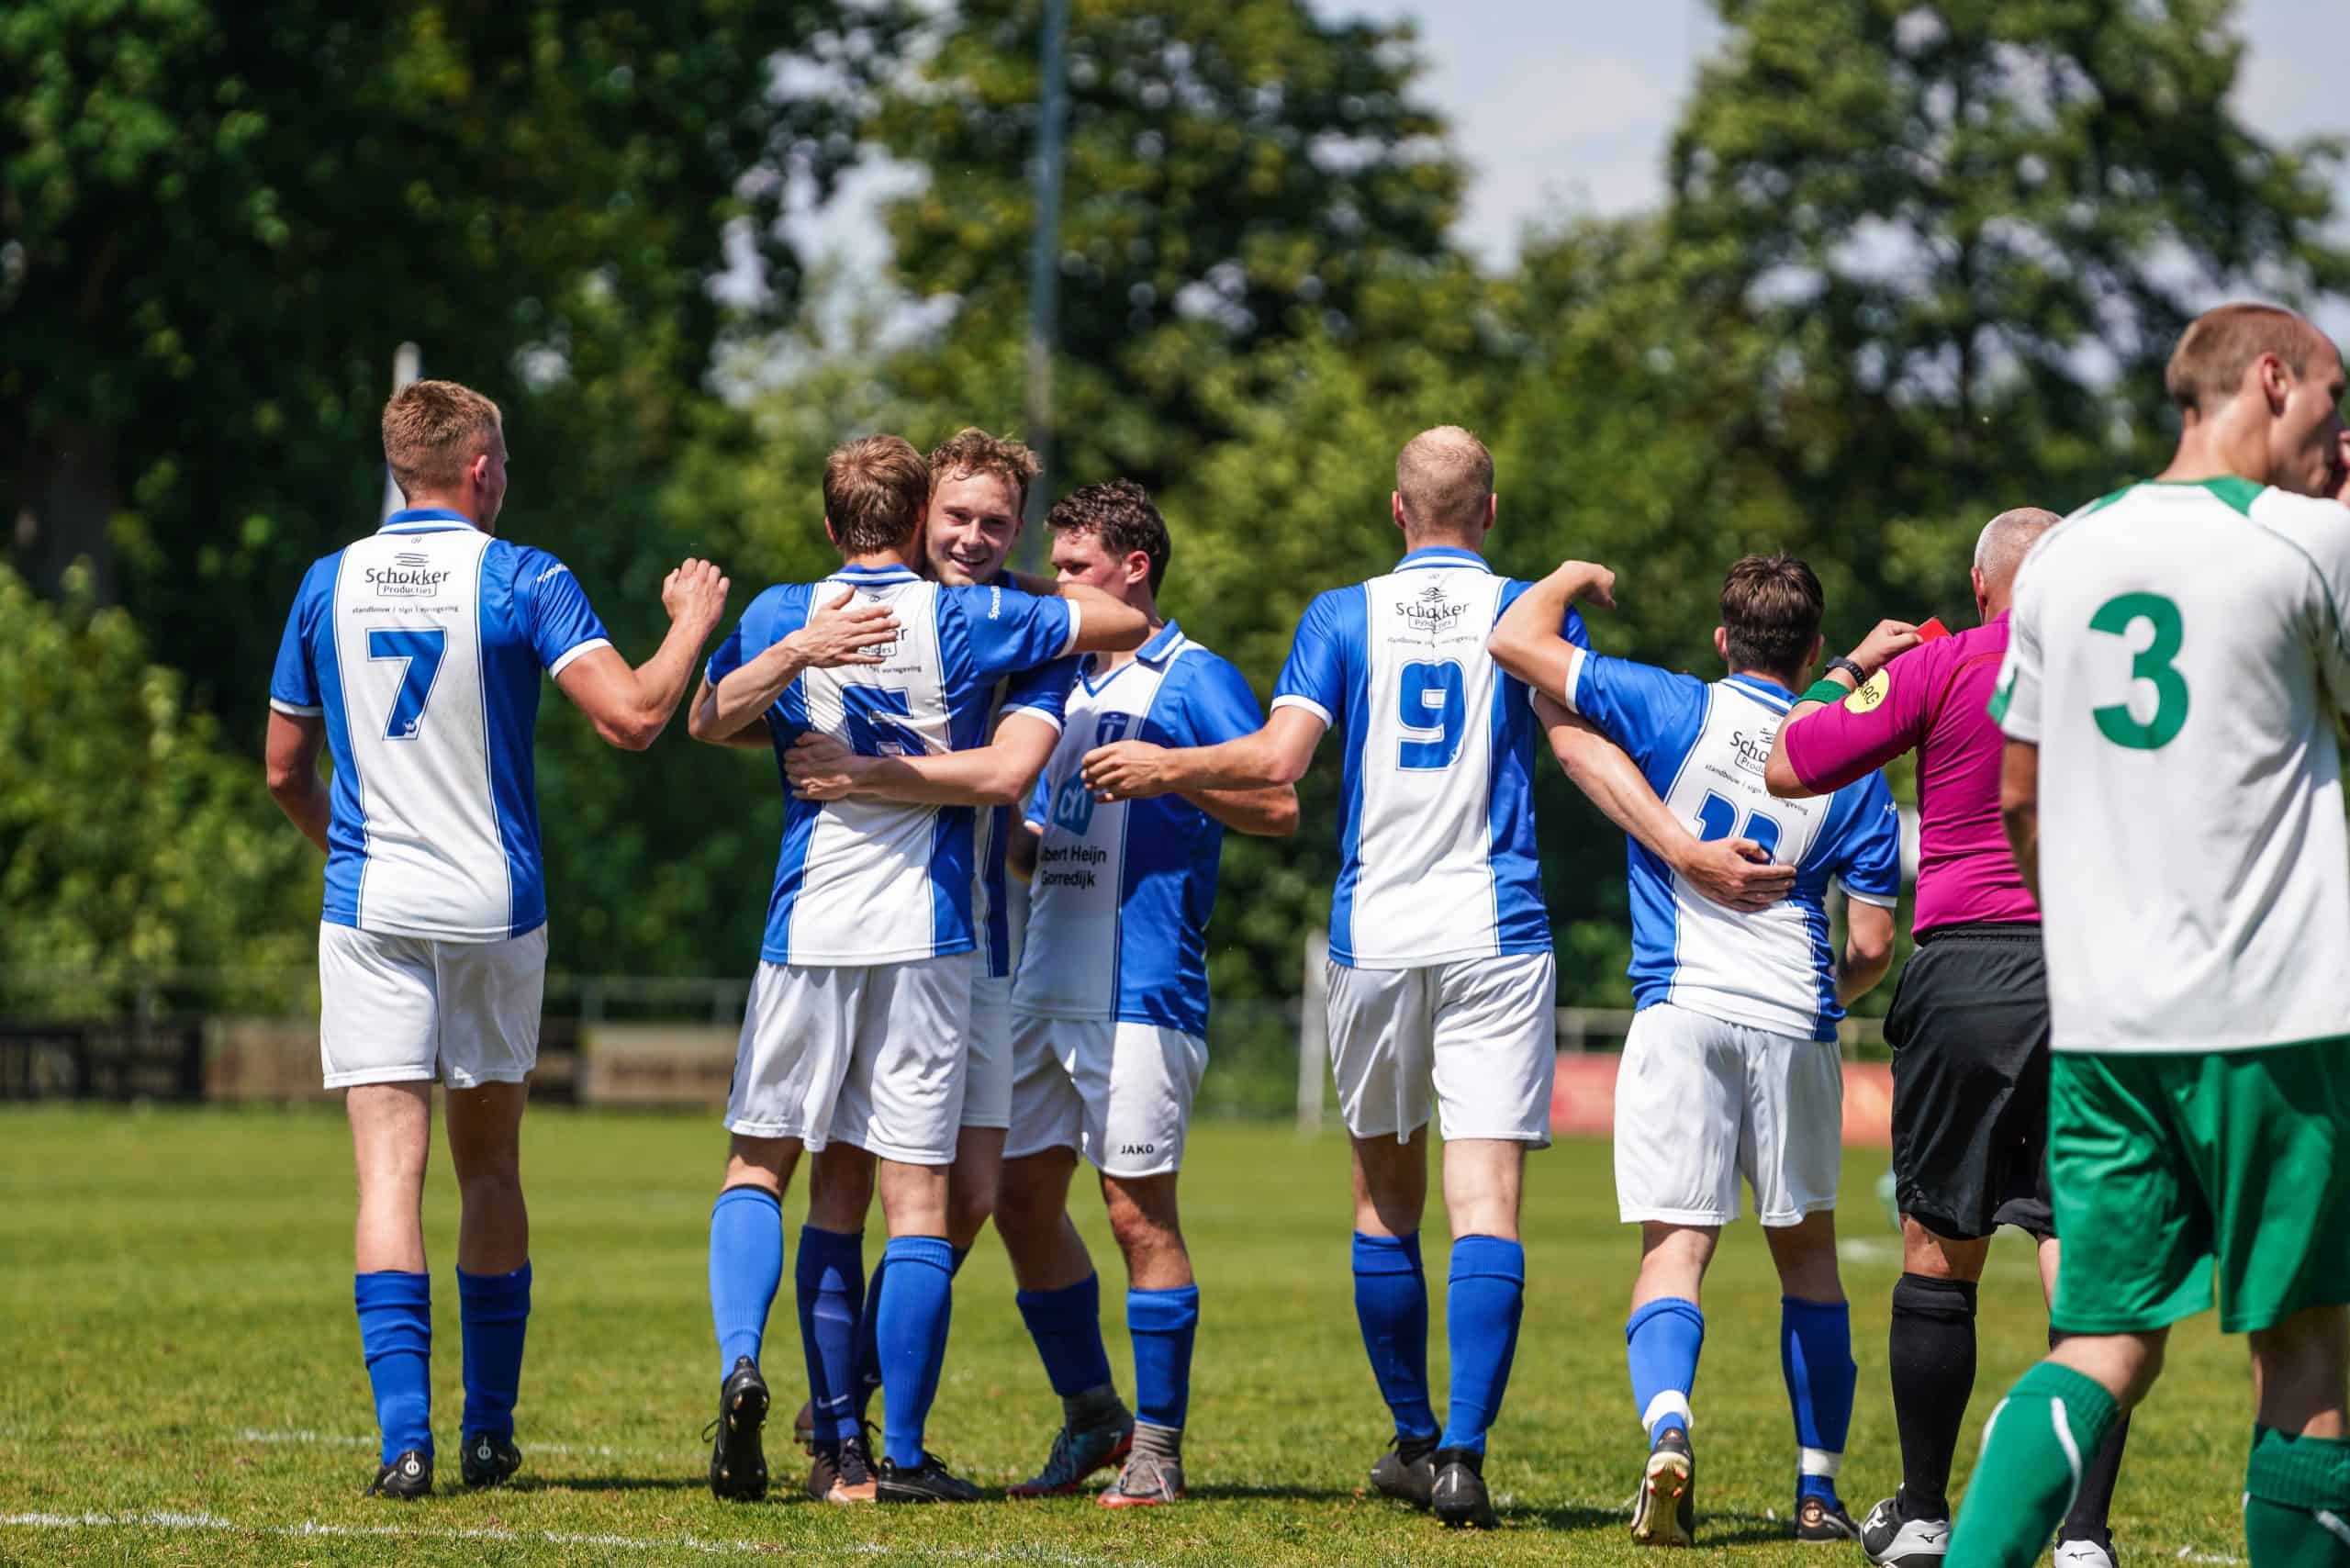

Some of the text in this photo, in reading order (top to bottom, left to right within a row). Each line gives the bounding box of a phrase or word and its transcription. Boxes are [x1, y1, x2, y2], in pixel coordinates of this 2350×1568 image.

[364, 566, 451, 585] Schokker
[383, 585, 431, 594] Producties
[2087, 590, 2190, 750] 3
[365, 625, 449, 742] 7
[1395, 656, 1470, 772] 9
[1729, 731, 1769, 763] Scho
[1040, 844, 1107, 865] bert Heijn
[1120, 1144, 1154, 1155] JAKO
